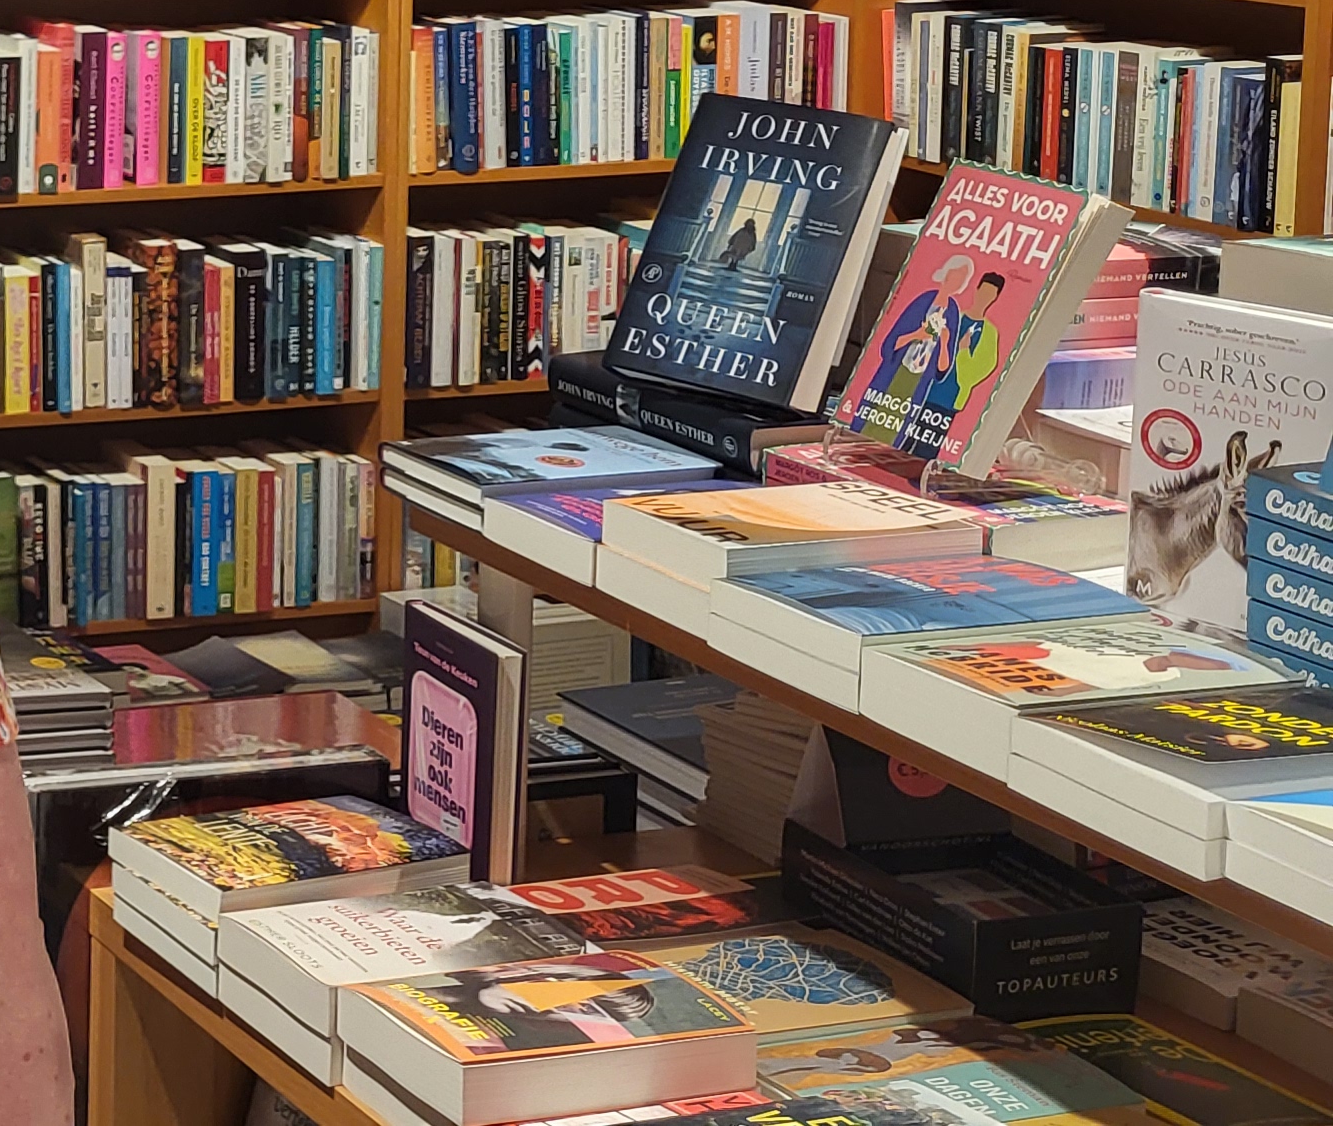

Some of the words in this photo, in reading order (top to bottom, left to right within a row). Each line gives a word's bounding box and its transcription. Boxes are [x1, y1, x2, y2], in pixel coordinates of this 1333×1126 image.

[727, 111, 841, 151] JOHN
[699, 144, 844, 192] IRVING
[946, 178, 1008, 211] ALLES
[1010, 191, 1069, 225] VOOR
[925, 204, 1062, 270] AGAATH
[785, 290, 816, 303] ROMAN
[1135, 271, 1188, 282] VERTELLEN
[646, 292, 789, 346] QUEEN
[1089, 313, 1131, 323] NIEMAND
[621, 327, 782, 388] ESTHER
[1157, 352, 1327, 403] CARRASCO
[1214, 346, 1267, 368] JESÚS
[557, 379, 582, 399] JOHN
[582, 388, 615, 410] IRVING
[863, 385, 919, 418] MARGÔT
[924, 408, 953, 428] ROS
[1162, 378, 1202, 398] ODE
[1212, 389, 1260, 412] AAN
[1266, 397, 1318, 421] MIJN
[1193, 401, 1282, 431] HANDEN
[640, 409, 674, 432] QUEEN
[675, 421, 715, 447] ESTHER
[841, 398, 853, 414] &
[854, 404, 906, 435] JEROEN
[906, 423, 963, 456] KLEIJNE
[632, 497, 750, 545] VUUR
[821, 481, 953, 522] SPEEL
[422, 705, 464, 751] Dieren
[1153, 703, 1330, 747] PARDON
[430, 740, 453, 769] zijn
[428, 764, 453, 794] ook
[414, 777, 467, 825] mensen
[308, 914, 379, 958] groeien
[329, 904, 427, 966] suikerbieten
[377, 906, 416, 937] Waar
[417, 932, 443, 951] de
[996, 967, 1119, 996] TOPAUTEURS
[388, 982, 491, 1041] BIOGRAFIE
[696, 997, 731, 1022] LACEY
[923, 1075, 997, 1118] DAGEN
[968, 1078, 1029, 1114] ONZE
